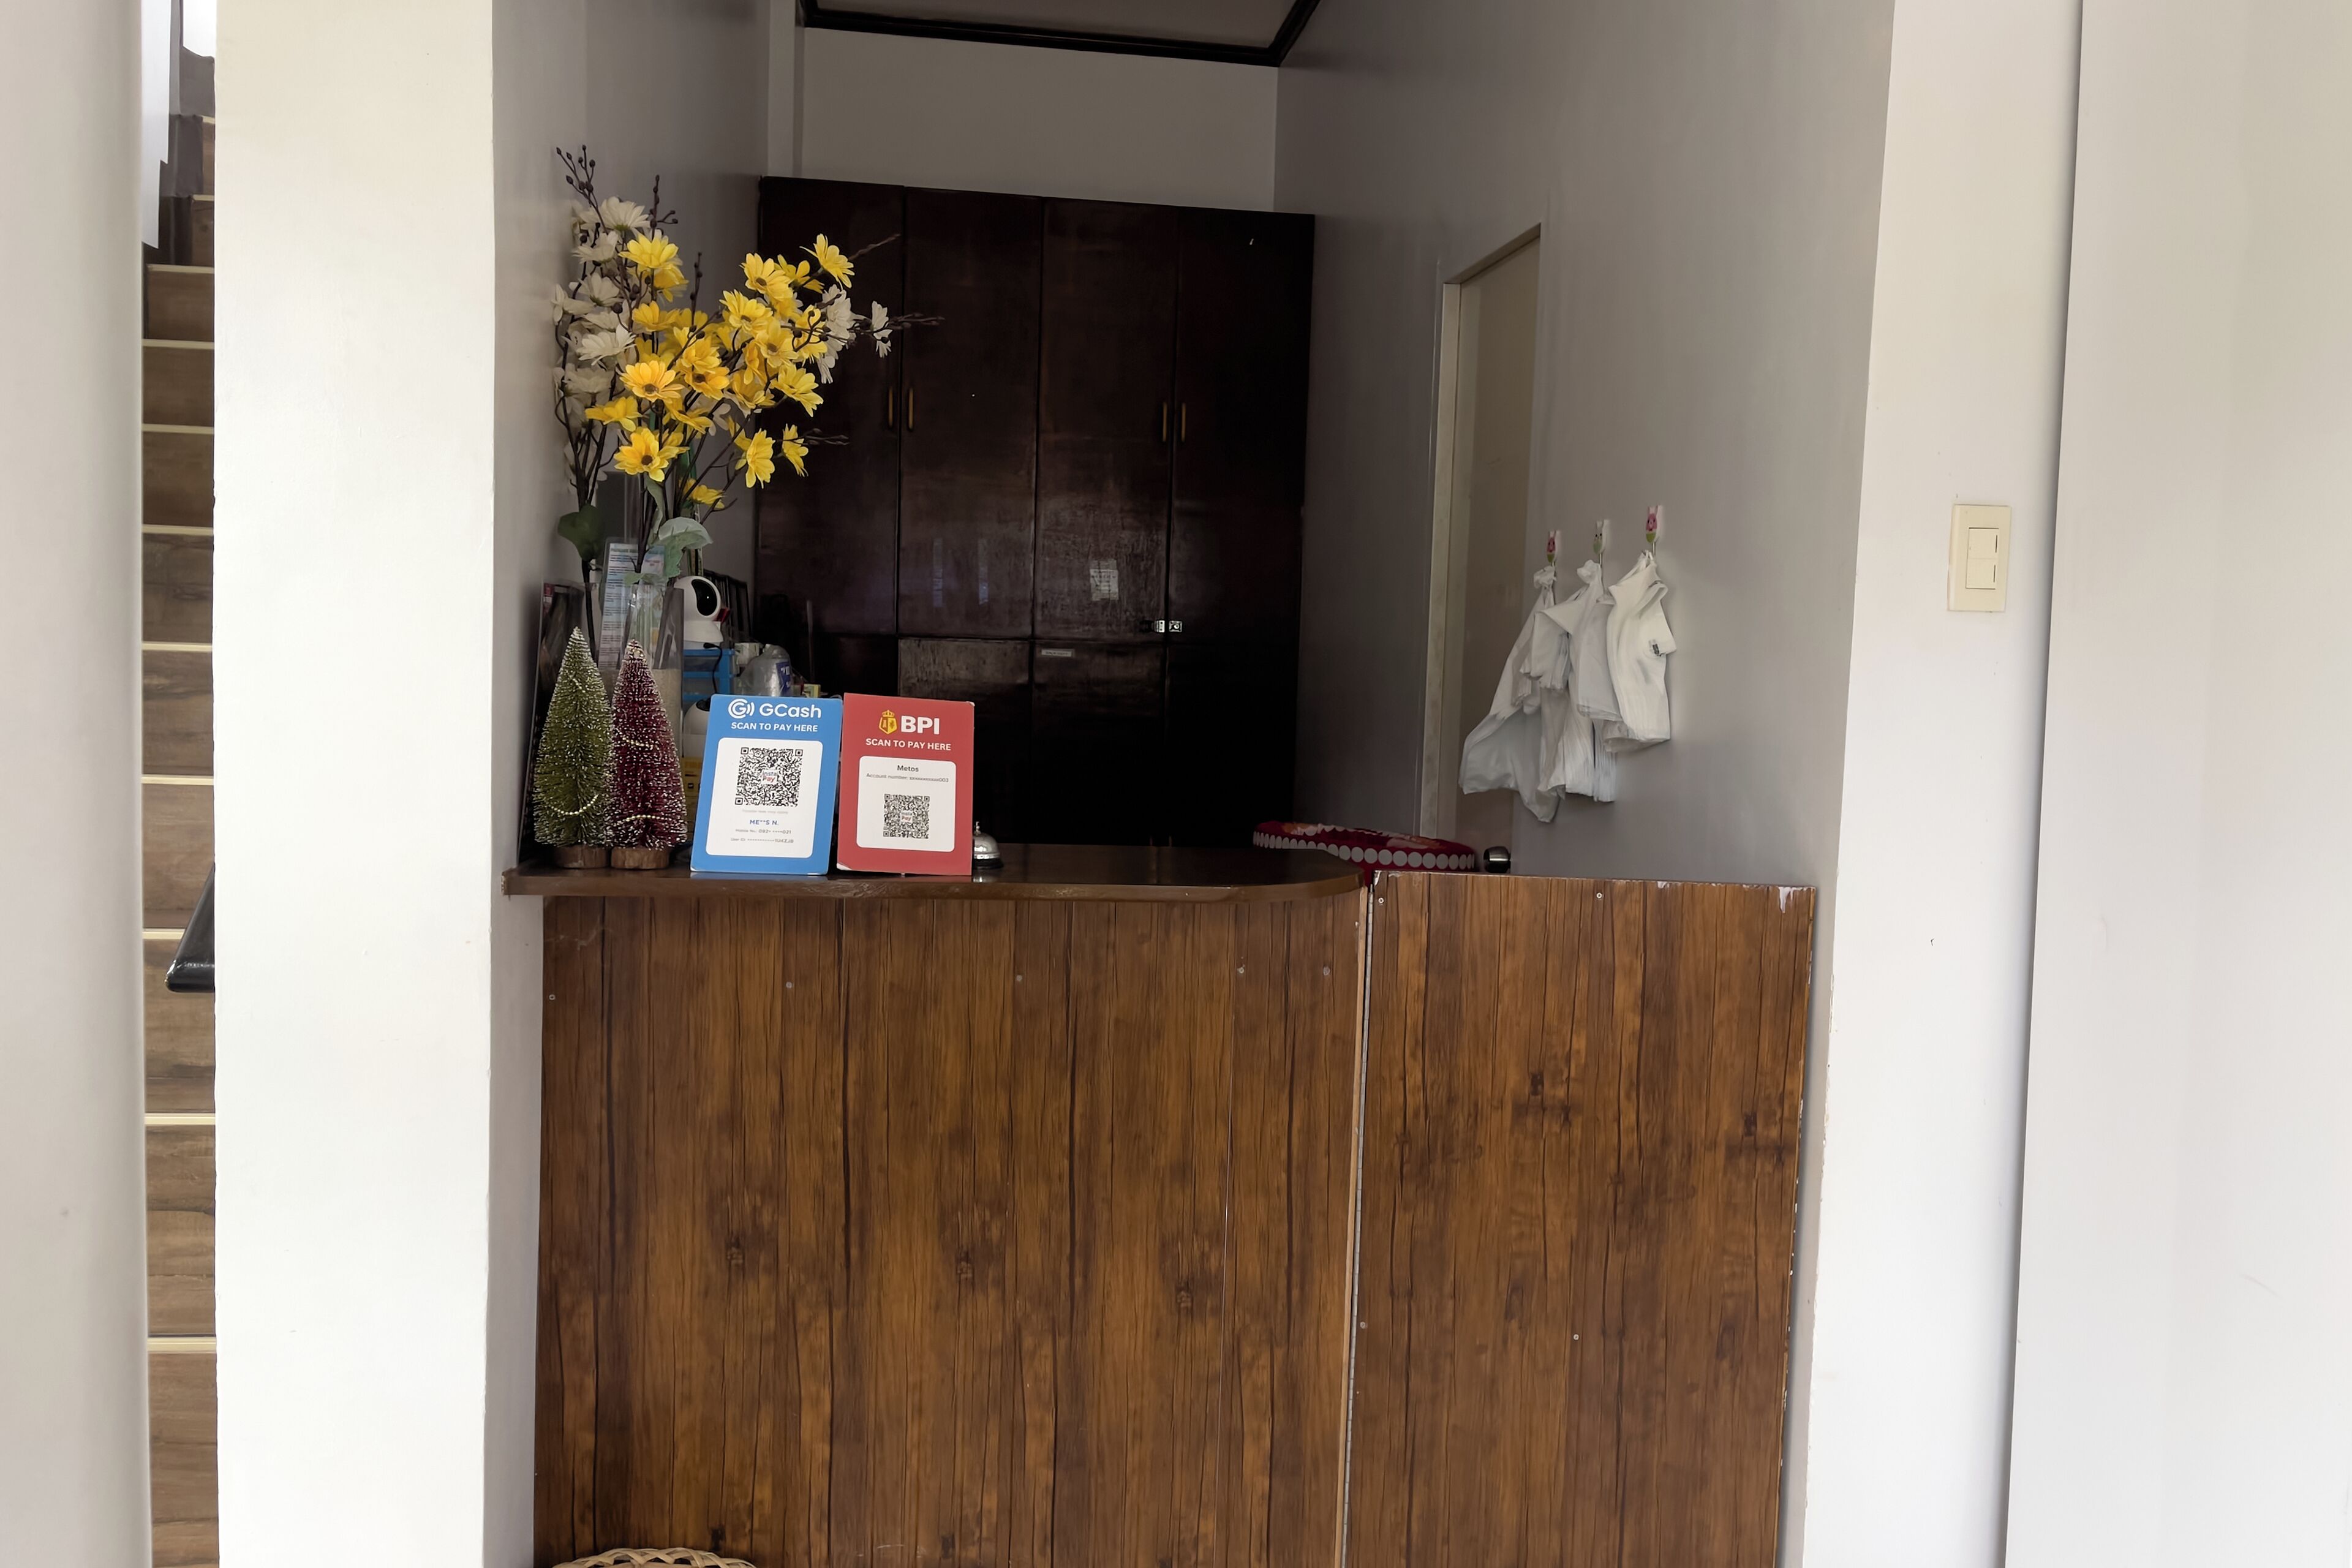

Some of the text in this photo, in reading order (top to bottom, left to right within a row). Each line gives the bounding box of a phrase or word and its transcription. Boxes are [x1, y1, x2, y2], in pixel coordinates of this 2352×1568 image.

[759, 703, 822, 718] GCash
[731, 722, 757, 730] SCAN
[900, 715, 940, 735] BPI
[865, 738, 891, 747] SCAN
[927, 742, 951, 751] HERE
